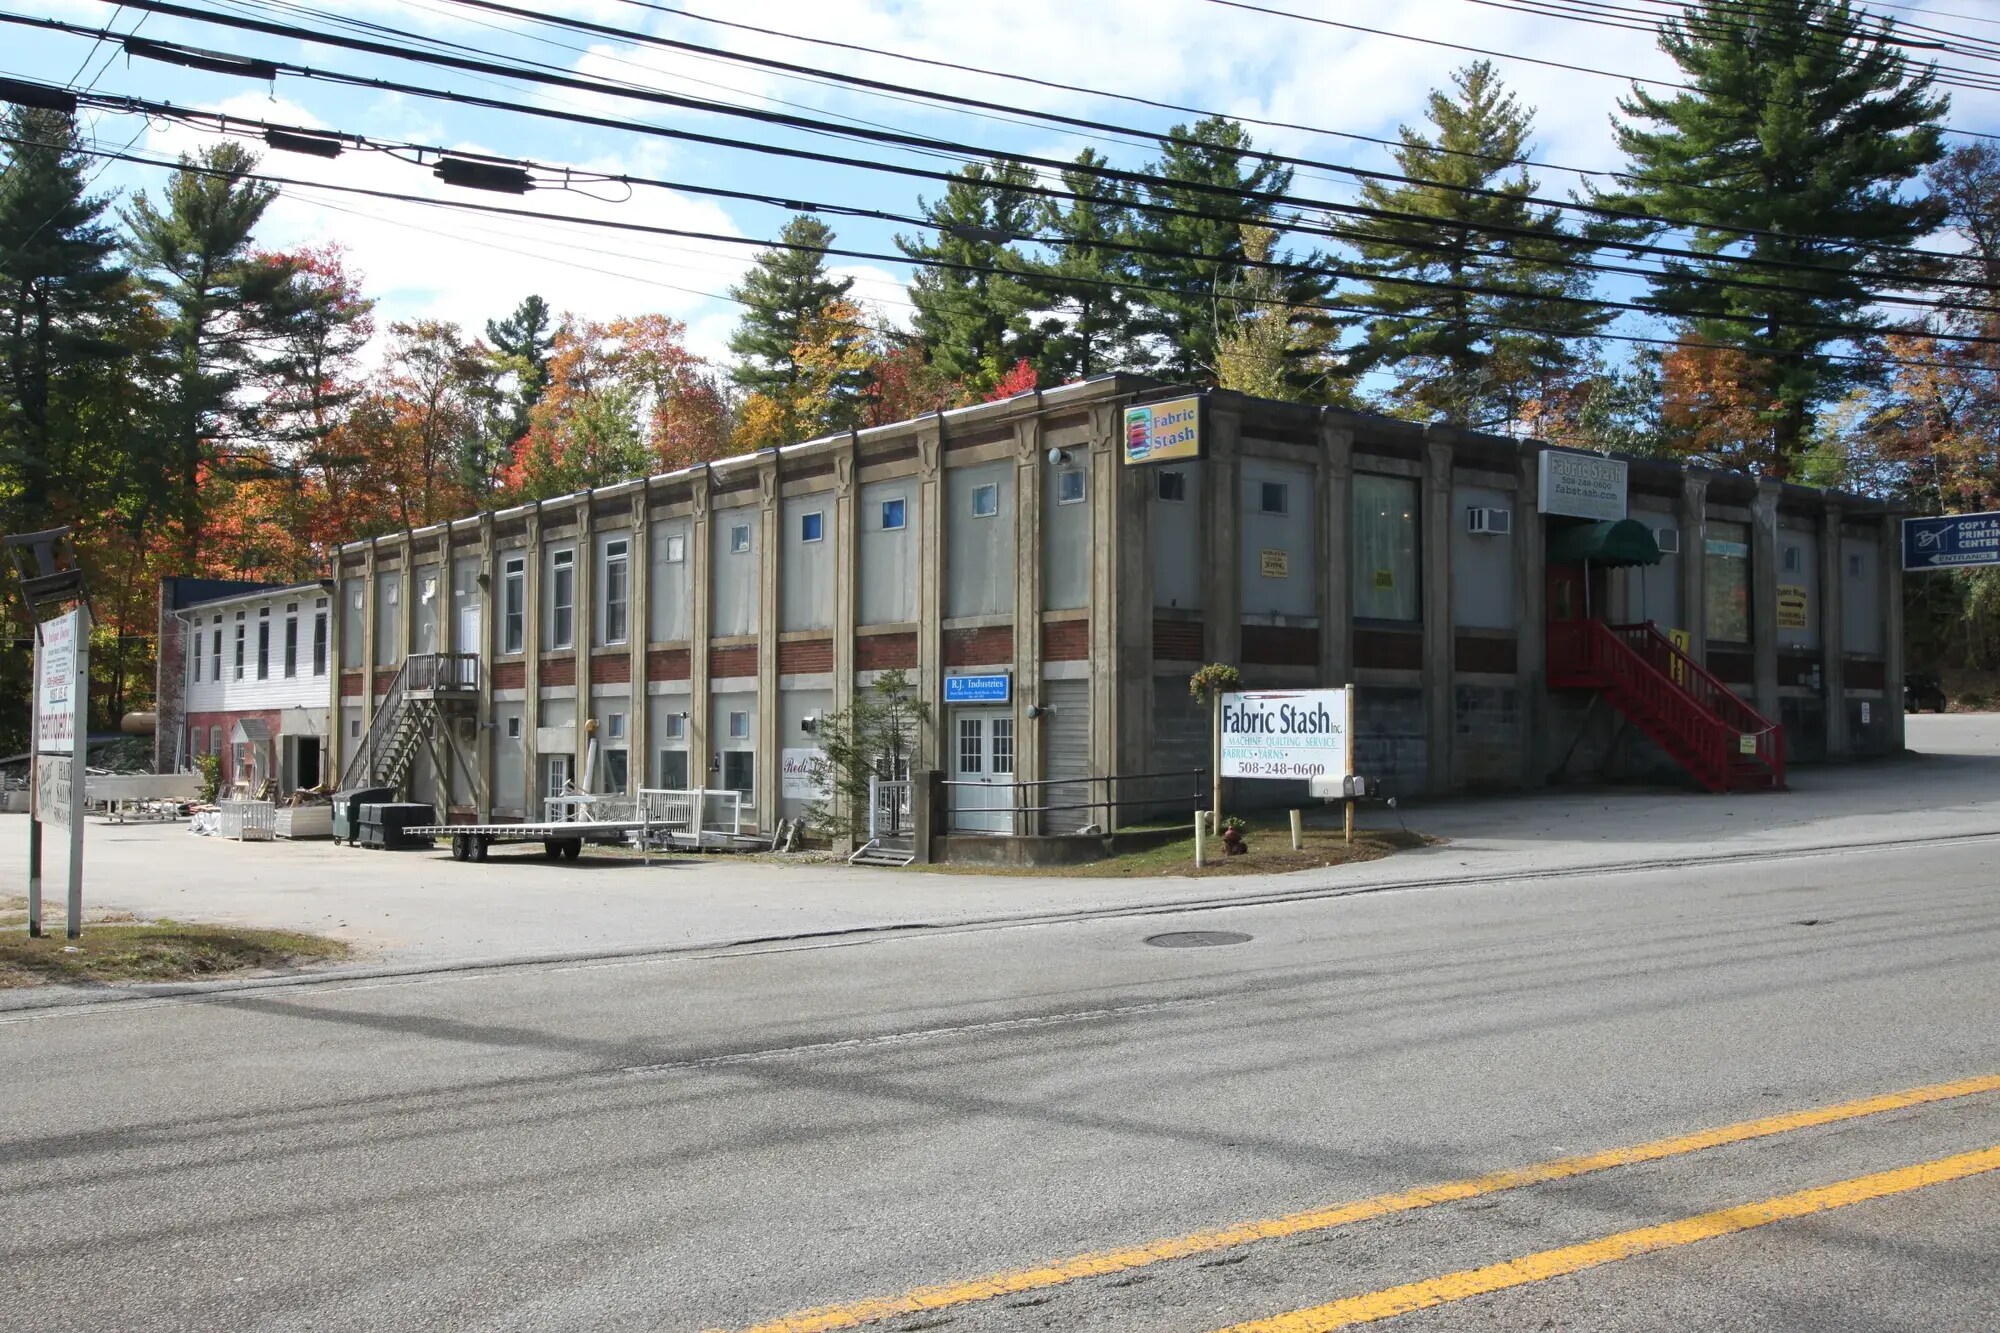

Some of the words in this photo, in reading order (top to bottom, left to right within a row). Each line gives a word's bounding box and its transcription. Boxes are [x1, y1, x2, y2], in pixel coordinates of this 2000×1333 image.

[1153, 409, 1194, 428] Fabric
[1154, 426, 1195, 449] Stash
[1551, 456, 1588, 478] Fabric
[1591, 461, 1621, 483] Stash
[1561, 476, 1612, 490] 508-248-0600
[1555, 484, 1618, 500] fabstash.com
[1958, 521, 1987, 530] COPY
[1990, 519, 1999, 528] &
[1958, 538, 1999, 548] CENTER
[1938, 552, 1993, 562] ENTRANCE
[951, 679, 965, 691] R.J.
[968, 678, 1004, 689] Industries
[1223, 703, 1275, 734] Fabric
[1280, 702, 1330, 734] Stash
[1228, 736, 1262, 746] MACHINE
[1266, 736, 1301, 747] QUILTING
[1305, 737, 1336, 747] SERVICE
[1223, 749, 1253, 759] FABRICS
[1258, 749, 1284, 760] YARNS
[1238, 762, 1325, 775] 508-248-0600
